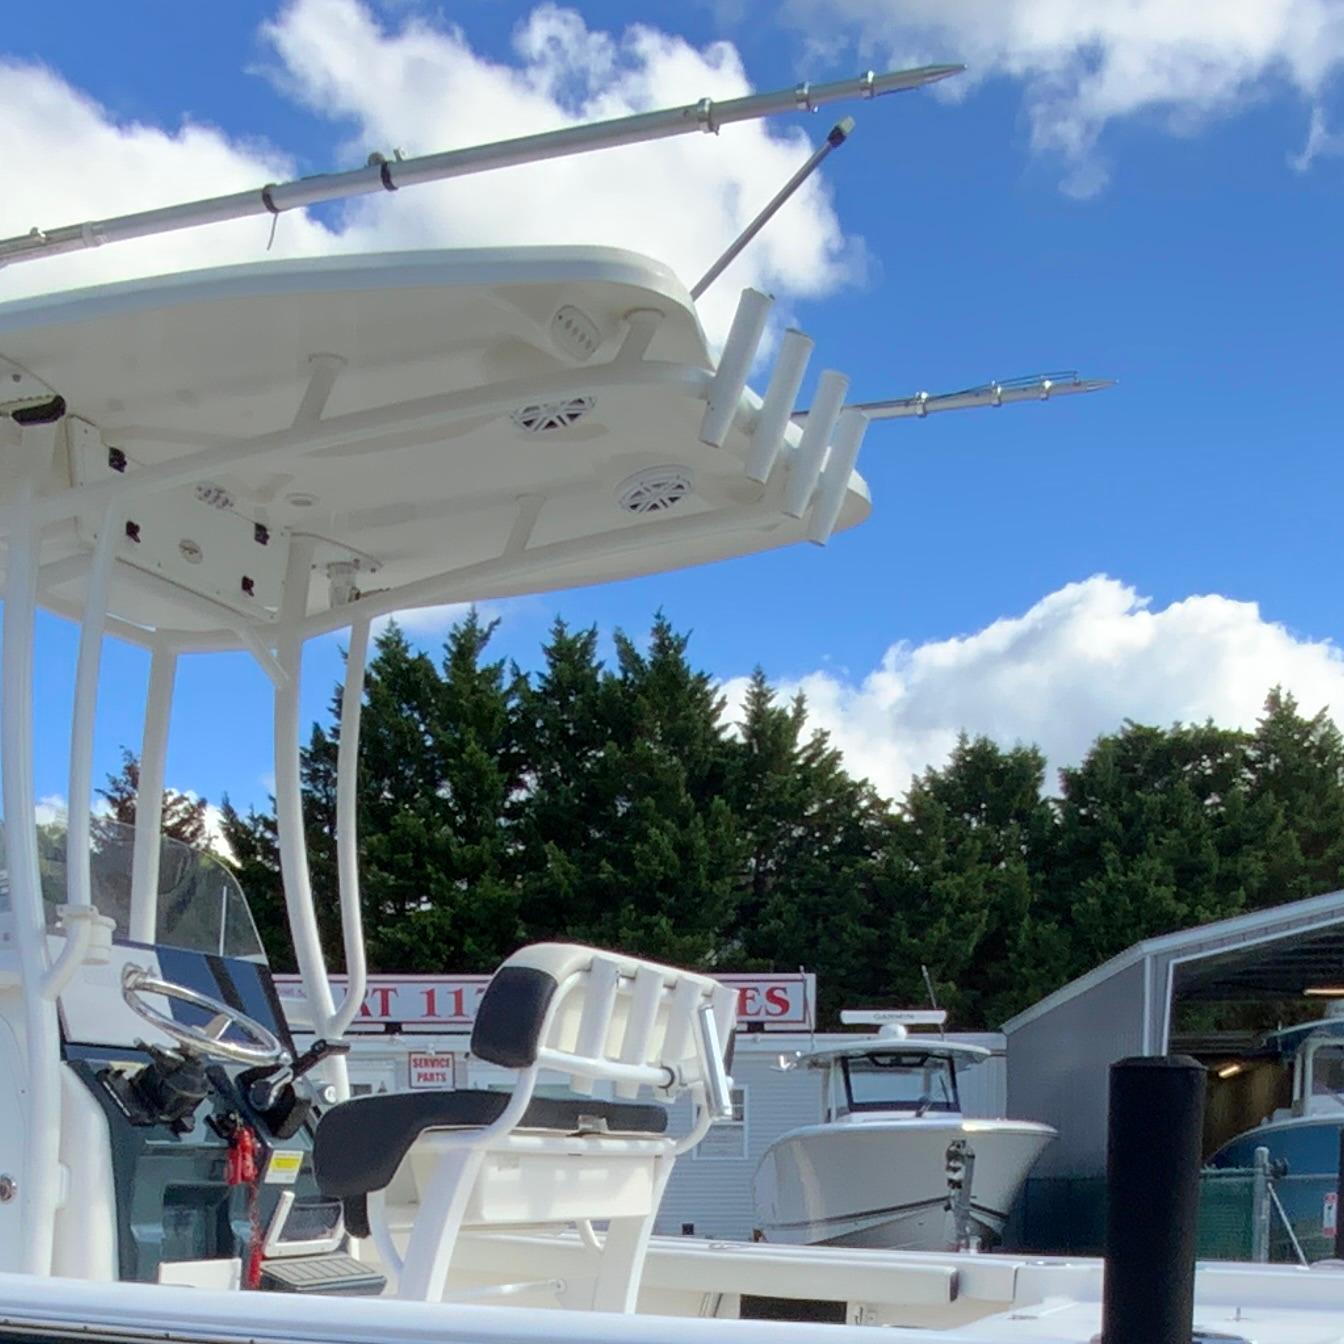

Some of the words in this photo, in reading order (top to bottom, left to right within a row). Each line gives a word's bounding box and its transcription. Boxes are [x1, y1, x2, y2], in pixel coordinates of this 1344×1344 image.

[420, 988, 485, 1017] 11
[412, 1058, 450, 1069] SERVICE
[417, 1072, 447, 1083] PARTS
